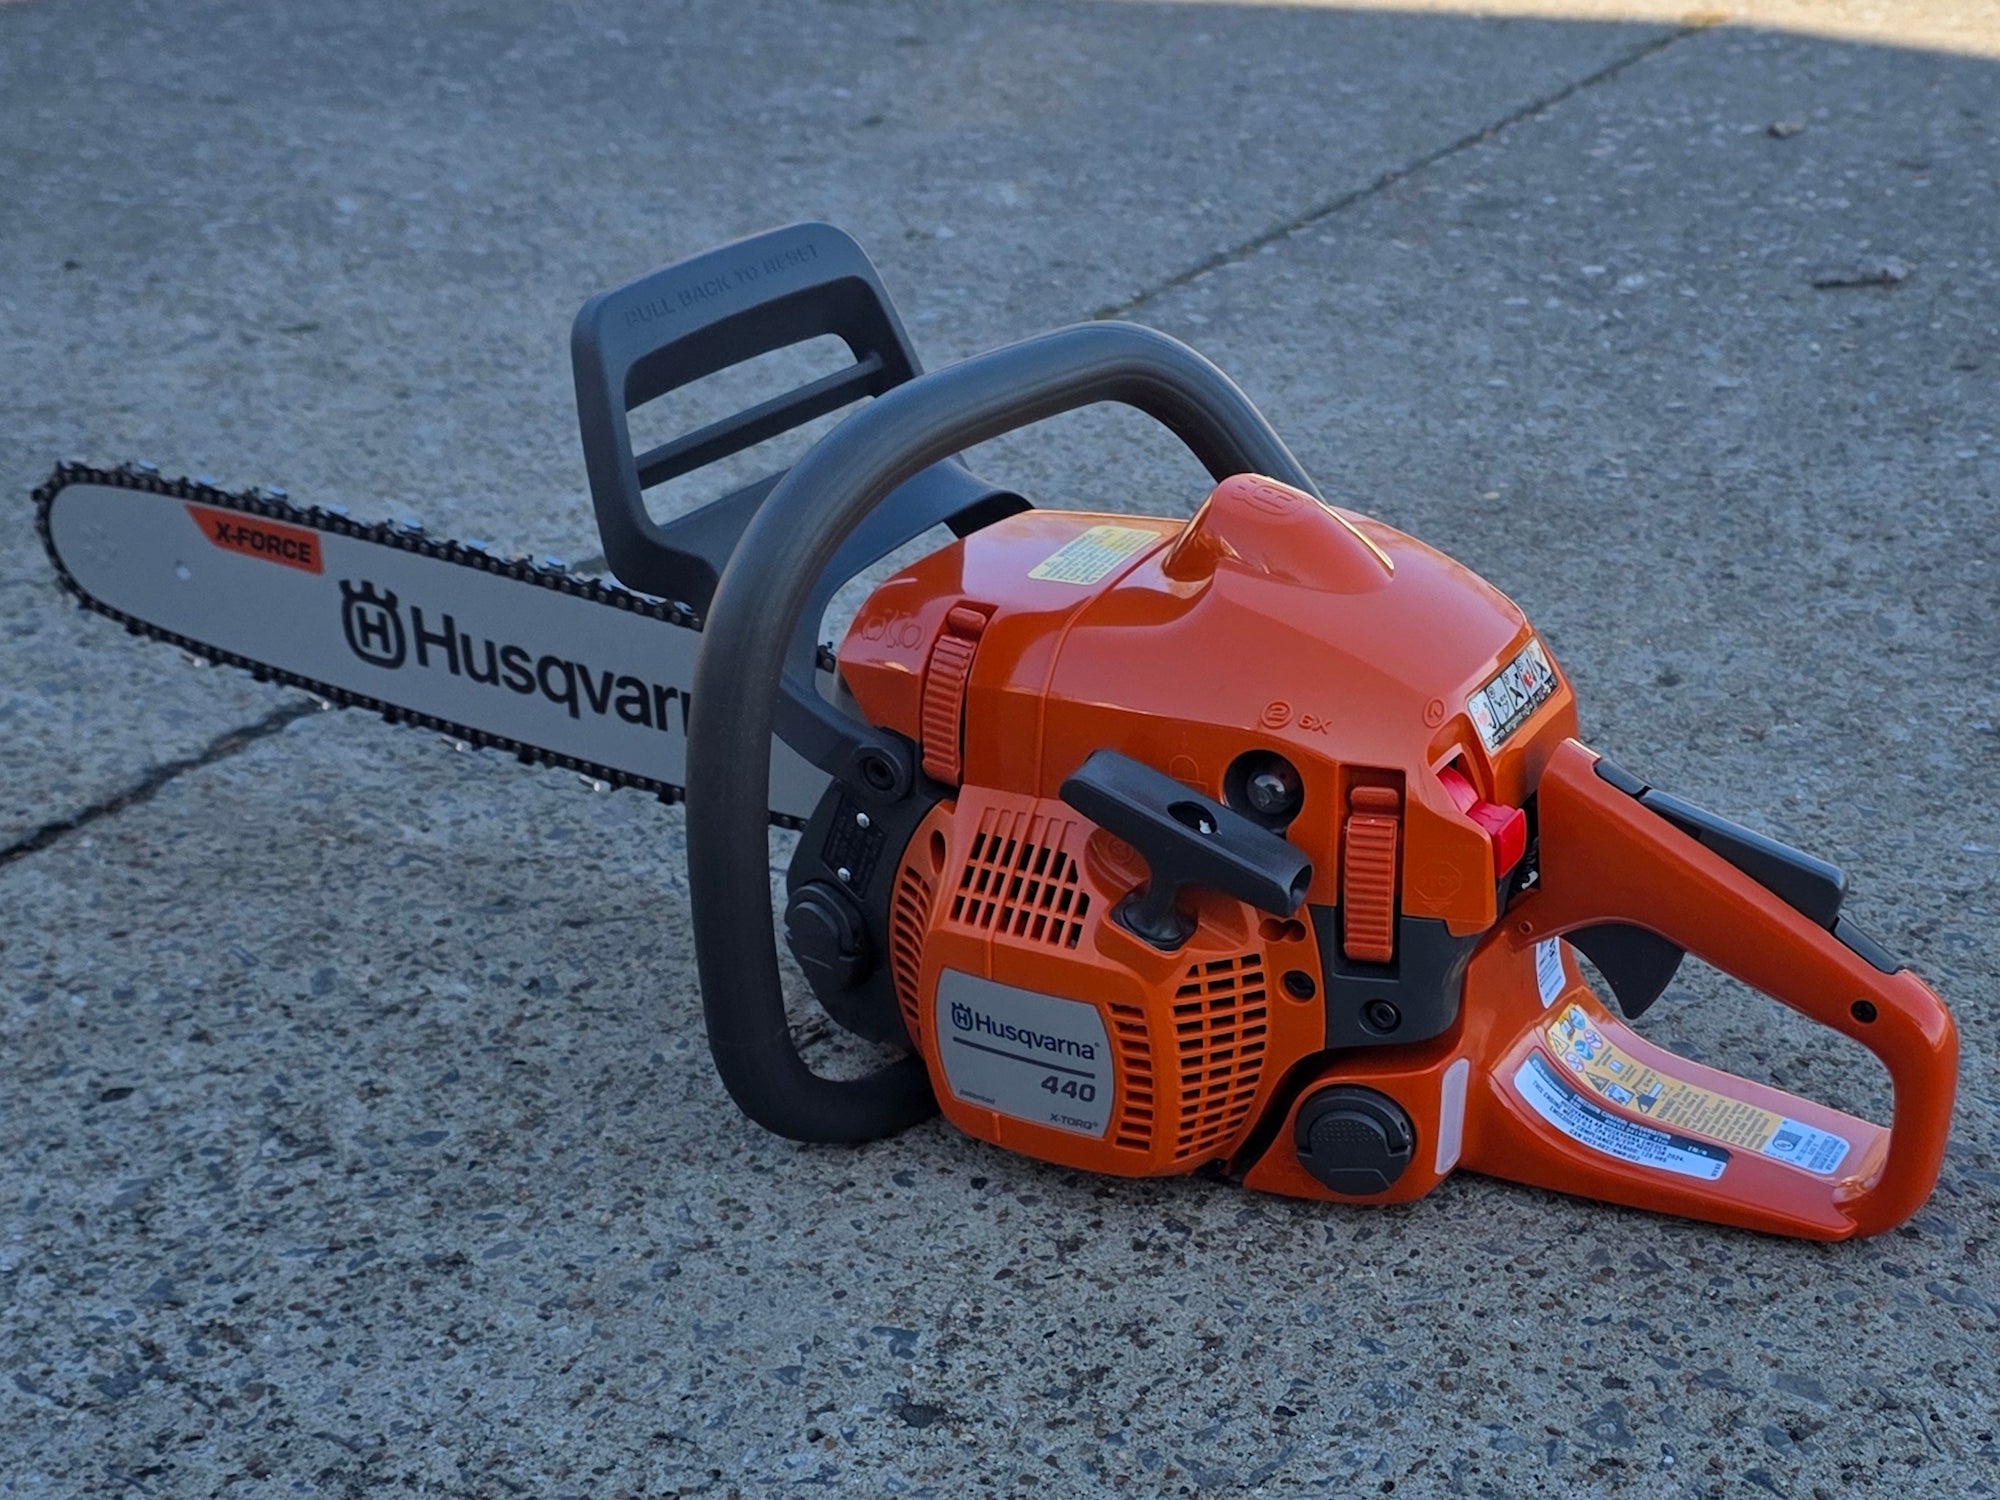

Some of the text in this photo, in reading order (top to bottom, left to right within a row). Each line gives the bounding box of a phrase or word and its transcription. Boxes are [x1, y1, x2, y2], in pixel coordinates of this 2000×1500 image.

[623, 244, 817, 326] PULL BACK TO RESET
[214, 519, 312, 564] X-FORCE
[975, 1011, 1096, 1060] Husqvarna
[1041, 1075, 1096, 1103] 440
